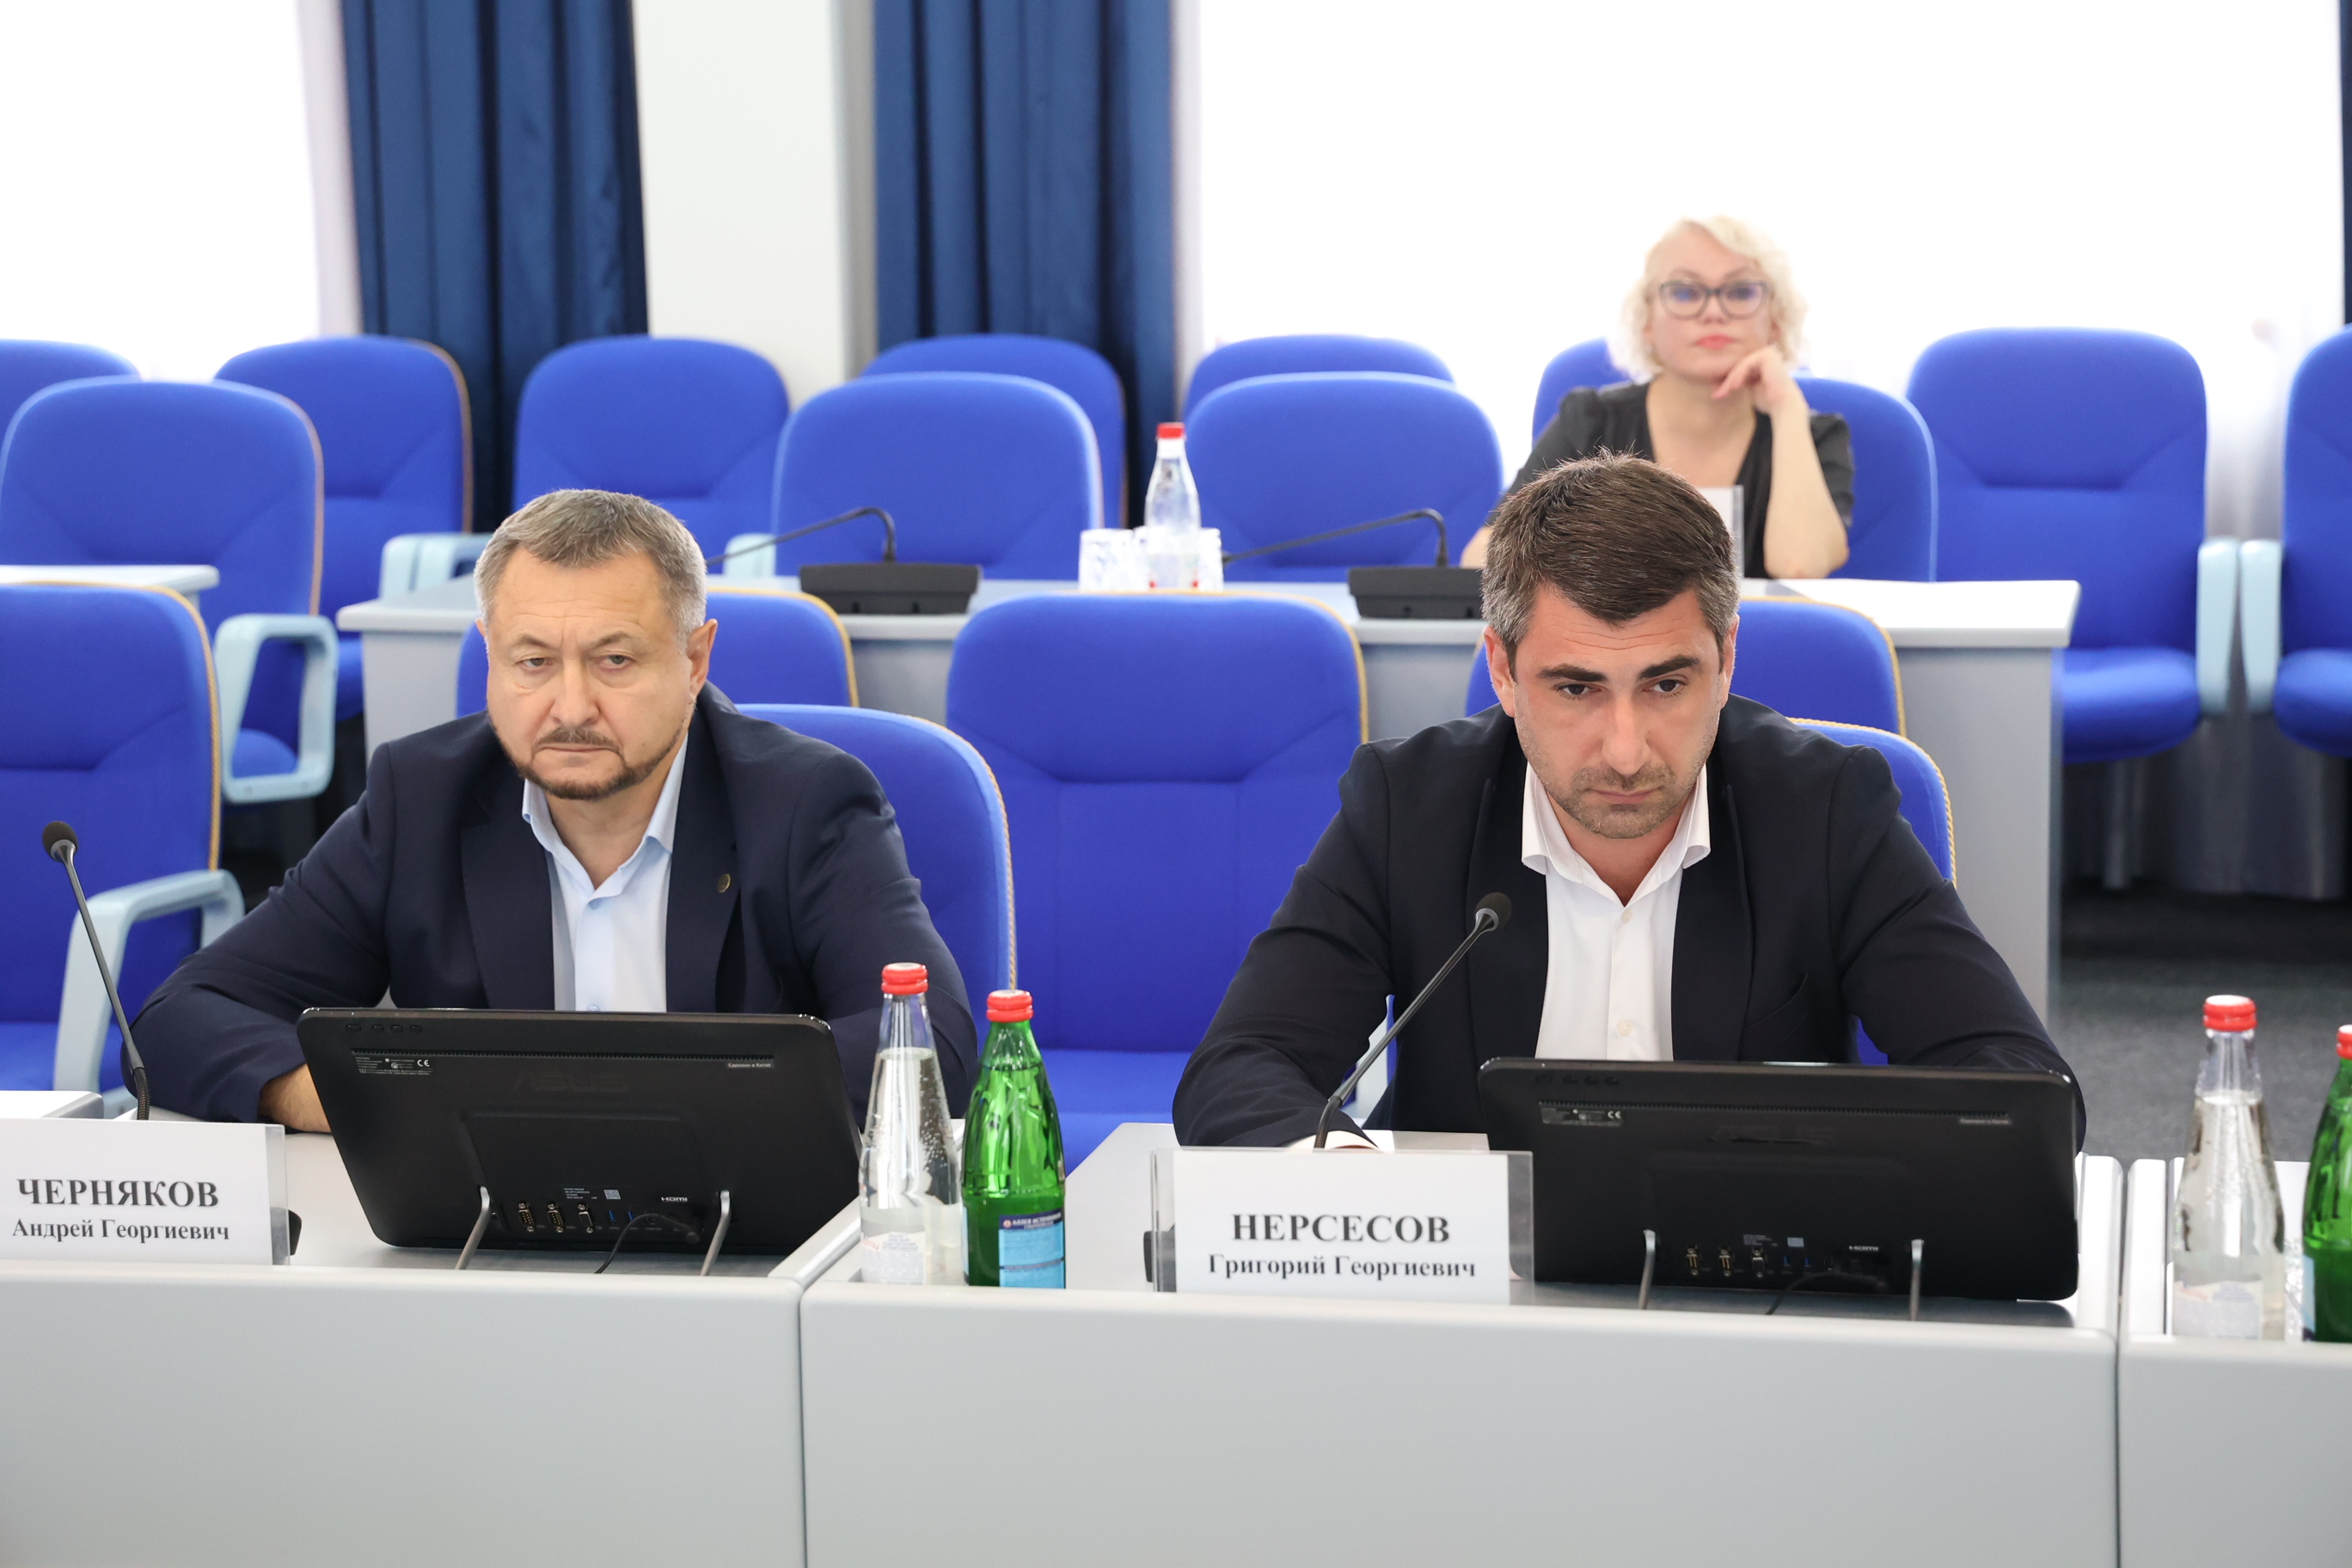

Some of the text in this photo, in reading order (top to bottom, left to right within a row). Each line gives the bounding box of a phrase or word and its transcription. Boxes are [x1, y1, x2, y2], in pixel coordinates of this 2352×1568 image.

[17, 1179, 220, 1208] ЧЕРНЯКОВ
[12, 1218, 230, 1245] Андрей Георгиевич
[1232, 1214, 1451, 1243] НЕРСЕСОВ
[1209, 1254, 1476, 1282] Григорий Георгиевич
